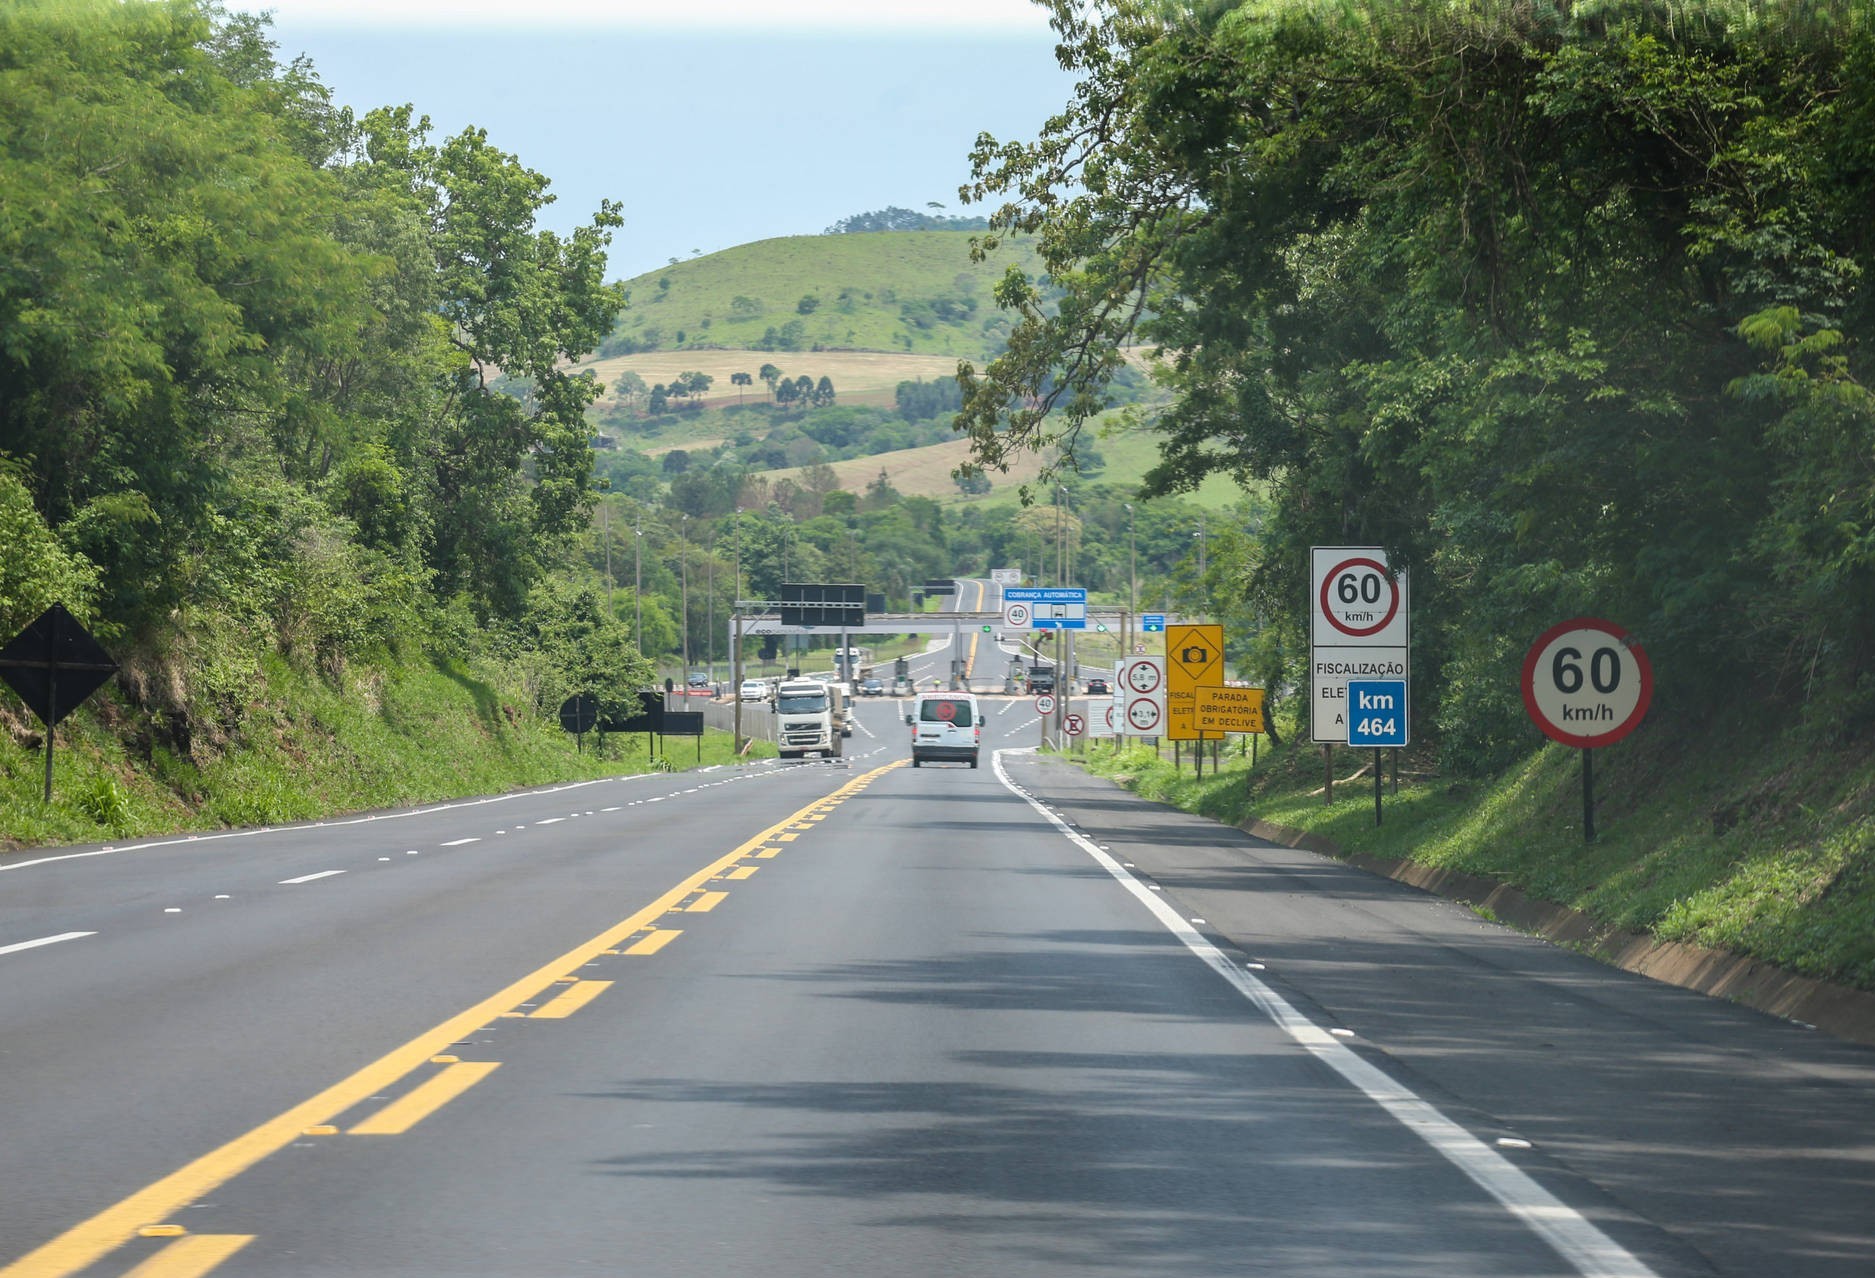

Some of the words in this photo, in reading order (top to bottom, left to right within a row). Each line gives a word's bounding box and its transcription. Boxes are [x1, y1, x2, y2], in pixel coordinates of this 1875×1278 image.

[1007, 591, 1042, 599] COBRANÇA
[1043, 590, 1083, 599] AUTOMÁTICA
[1338, 573, 1380, 604] 60
[1011, 609, 1024, 618] 40
[1345, 611, 1374, 622] km/h
[1316, 661, 1404, 677] FISCALIZAÇÃO
[1552, 647, 1621, 694] 60
[1212, 692, 1248, 702] PARADA
[1322, 687, 1347, 699] ELE
[1039, 699, 1051, 707] 40
[1360, 690, 1394, 710] km
[1563, 703, 1613, 721] km/h
[1202, 717, 1215, 725] EM
[1219, 718, 1257, 727] DECLIVE
[1357, 717, 1397, 736] 464
